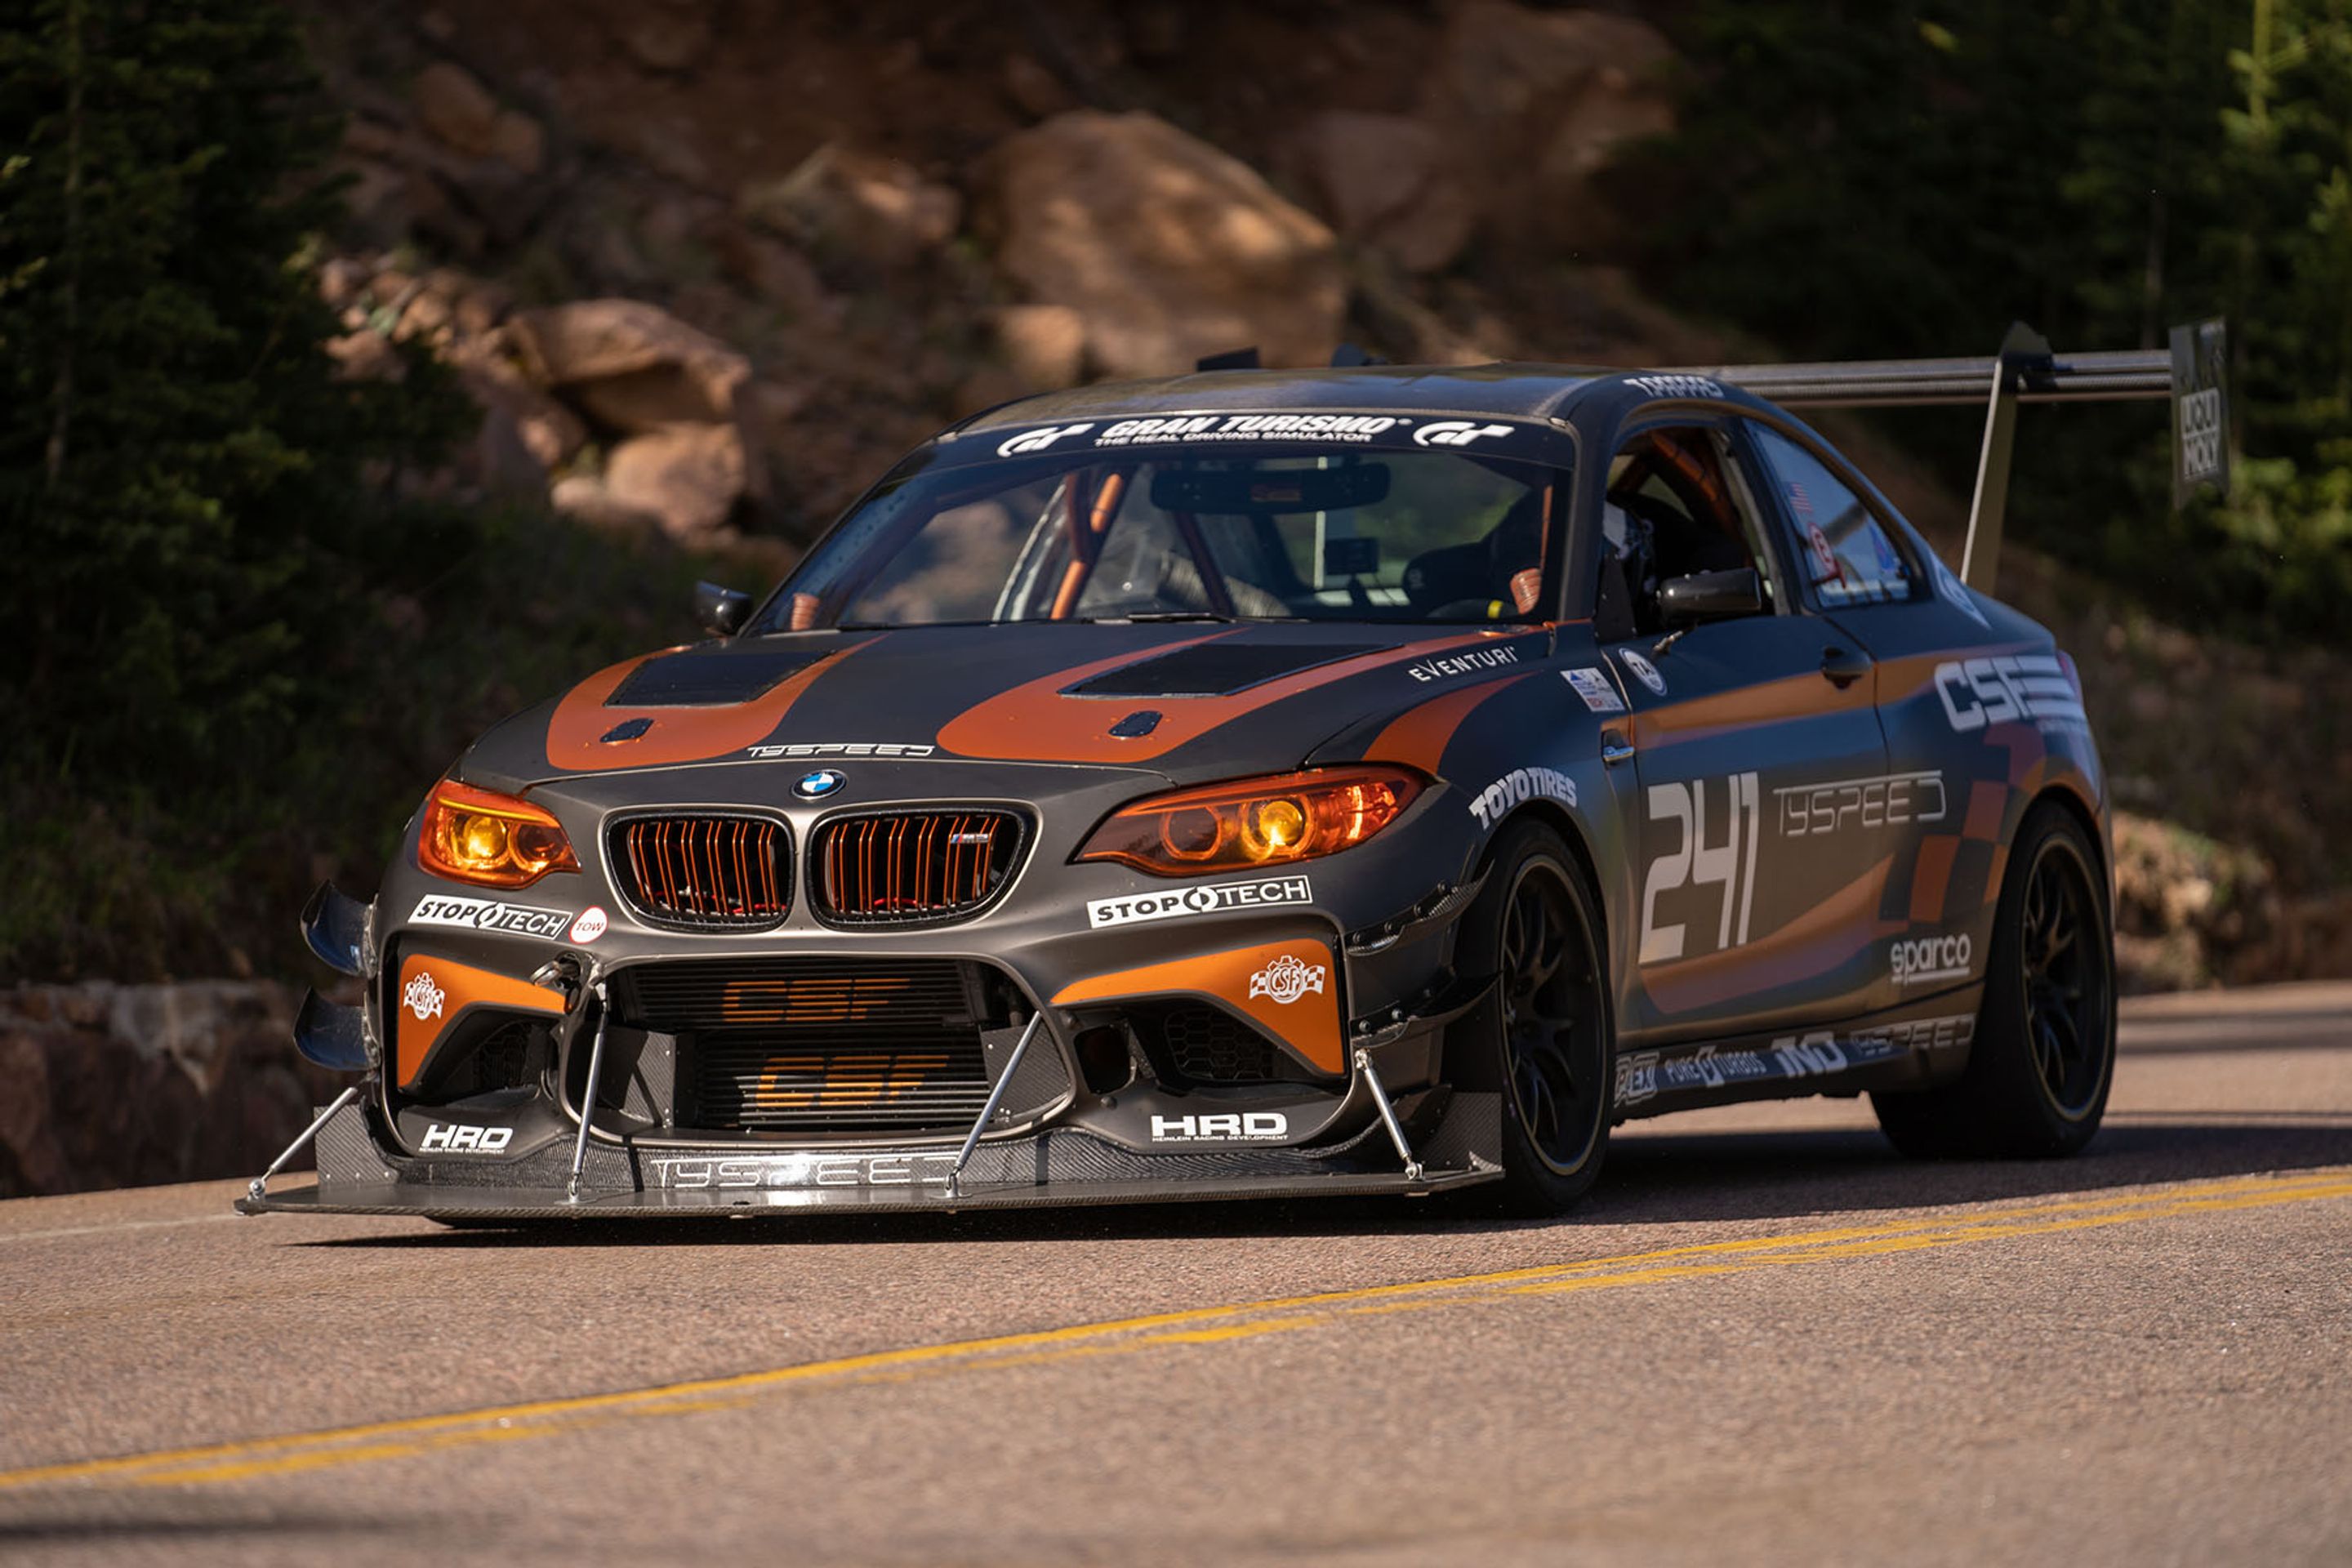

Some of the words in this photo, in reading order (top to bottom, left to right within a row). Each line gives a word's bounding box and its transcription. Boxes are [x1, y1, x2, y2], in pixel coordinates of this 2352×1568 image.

[1102, 416, 1220, 437] GRAN
[1218, 415, 1397, 434] TURISMO
[2181, 390, 2220, 434] LIQUI
[1094, 437, 1130, 448] THE
[1131, 434, 1180, 444] REAL
[1181, 431, 1259, 443] DRIVING
[1262, 431, 1373, 442] SIMULATOR
[2184, 434, 2219, 480] MOLY
[1408, 648, 1519, 681] EVENTURI
[1935, 655, 2085, 731] CSF
[1469, 772, 1530, 830] TOYO
[1526, 767, 1578, 808] TIRES
[1638, 771, 1758, 964] 241
[576, 921, 604, 932] TOW
[1890, 933, 1971, 985] sparco
[1271, 967, 1298, 992] CSF
[723, 978, 911, 1021] CSF
[421, 1125, 514, 1148] HRD
[1151, 1112, 1288, 1136] HRD
[1227, 1134, 1289, 1142] DEVELOPMENT
